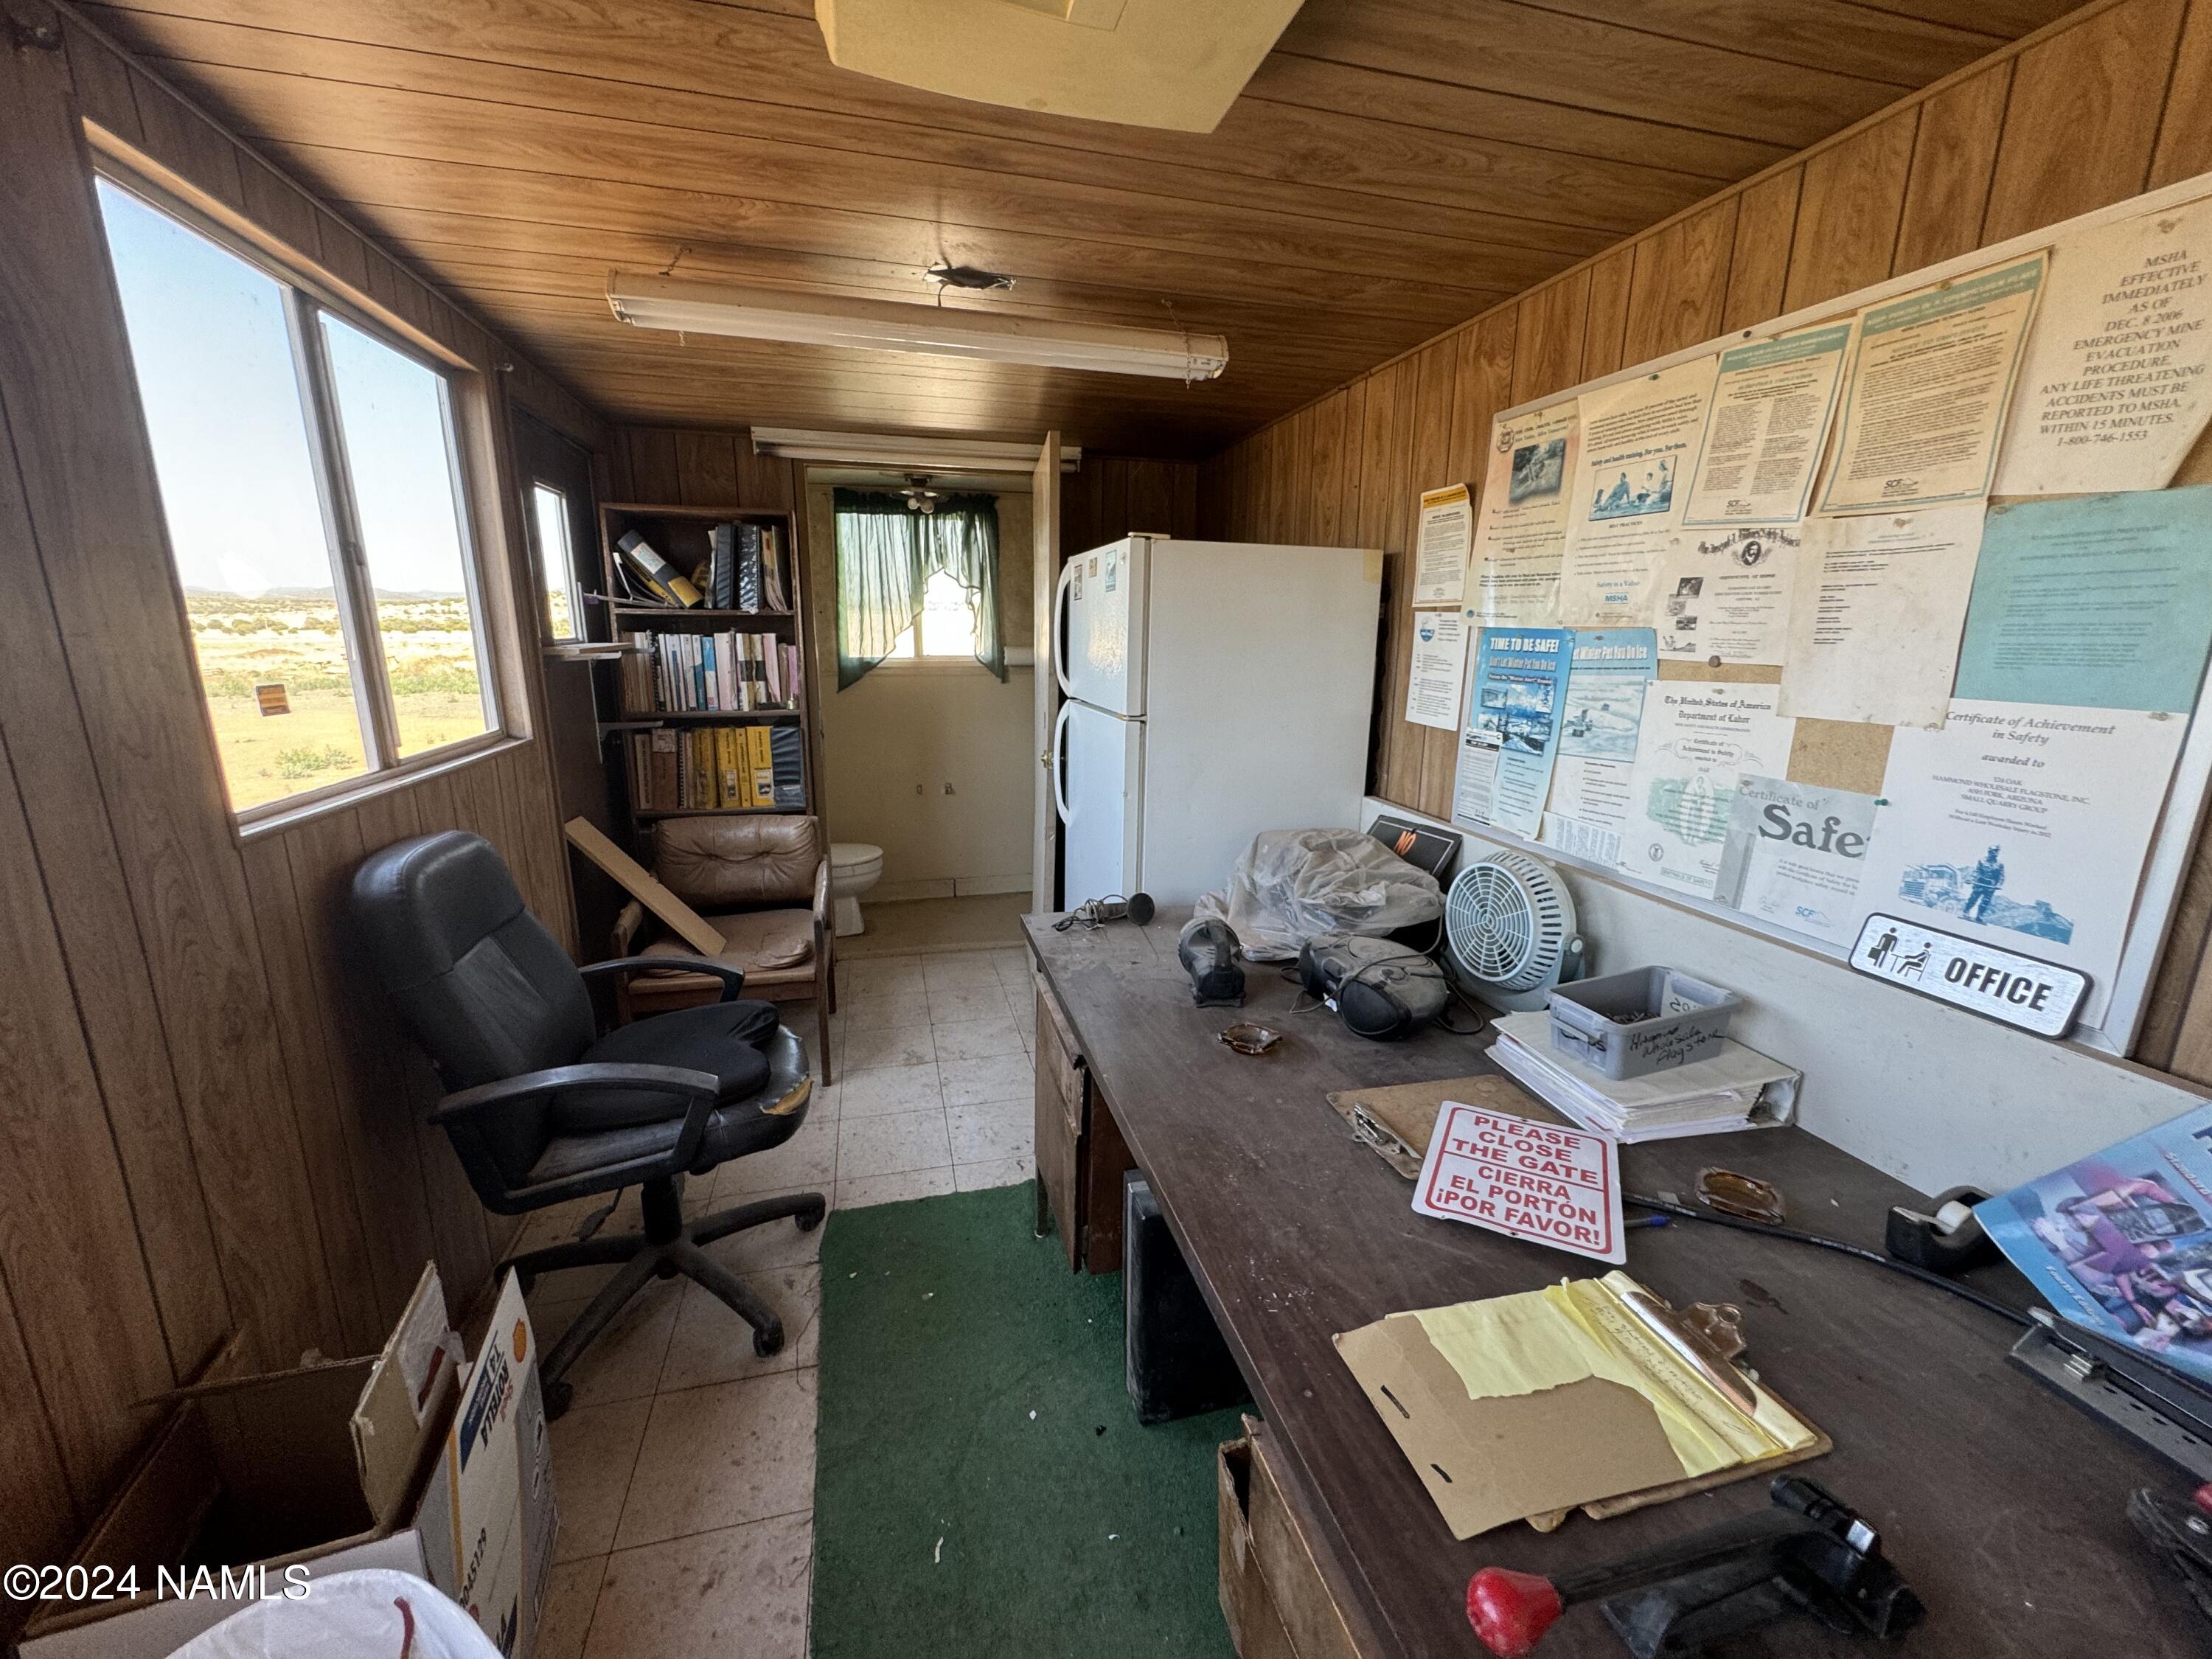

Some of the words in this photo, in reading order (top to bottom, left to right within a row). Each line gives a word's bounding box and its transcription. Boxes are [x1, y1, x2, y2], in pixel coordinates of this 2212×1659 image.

[2143, 250, 2186, 268] MSHA
[2119, 260, 2202, 287] EFFECTIVE
[2101, 273, 2209, 304] IMMEDIATELY
[2127, 301, 2149, 314] AS
[2152, 296, 2173, 310] OF
[2073, 327, 2166, 350] EMERGENCY
[2166, 319, 2205, 336] MINE
[2085, 339, 2182, 363] EVACUATION
[2039, 382, 2070, 394] ANY
[2072, 378, 2104, 391] LIFE
[2106, 364, 2206, 387] THREATENING
[2046, 390, 2125, 407] ACCIDENTS
[2128, 384, 2169, 399] MUST
[2169, 381, 2190, 394] BE
[2040, 421, 2090, 435] WITHIN
[2092, 419, 2107, 431] 15
[2109, 413, 2175, 430] MINUTES.
[2042, 406, 2114, 421] REPORTED
[2117, 403, 2137, 414] TO
[2056, 430, 2149, 447] 1-800-746-1553
[1604, 594, 1628, 602] MSHA
[1490, 637, 1510, 651] TIME
[1510, 637, 1523, 652] TO
[1523, 638, 1534, 653] BE
[1534, 639, 1560, 654] SAFE!
[1664, 695, 1678, 706] The
[1680, 695, 1704, 707] United
[1704, 697, 1729, 708] States
[1737, 698, 1771, 711] America
[1678, 709, 1717, 721] Department
[1946, 710, 2005, 726] Certificate
[2007, 715, 2023, 728] of
[2023, 717, 2116, 736] Achievement
[1992, 729, 2005, 740] in
[2006, 731, 2050, 747] Safety
[1982, 753, 2029, 768] awarded
[2031, 757, 2045, 769] to
[1739, 785, 1803, 808] Certificate
[1806, 799, 1820, 811] of
[1758, 803, 1871, 859] Safe
[1795, 905, 1815, 918] SCF
[1944, 956, 2054, 1012] OFFICE
[1475, 1115, 1582, 1150] PLEASE
[1478, 1130, 1572, 1163] CLOSE
[1453, 1138, 1509, 1163] THE
[1517, 1155, 1599, 1185] GATE
[1478, 1166, 1571, 1200] CIERRA
[1450, 1175, 1480, 1194] EL
[1488, 1185, 1597, 1225] PORTÓN
[1436, 1189, 1495, 1217] ¡POR
[1504, 1207, 1601, 1246] FAVOR!
[481, 1357, 509, 1452] ROTELLA
